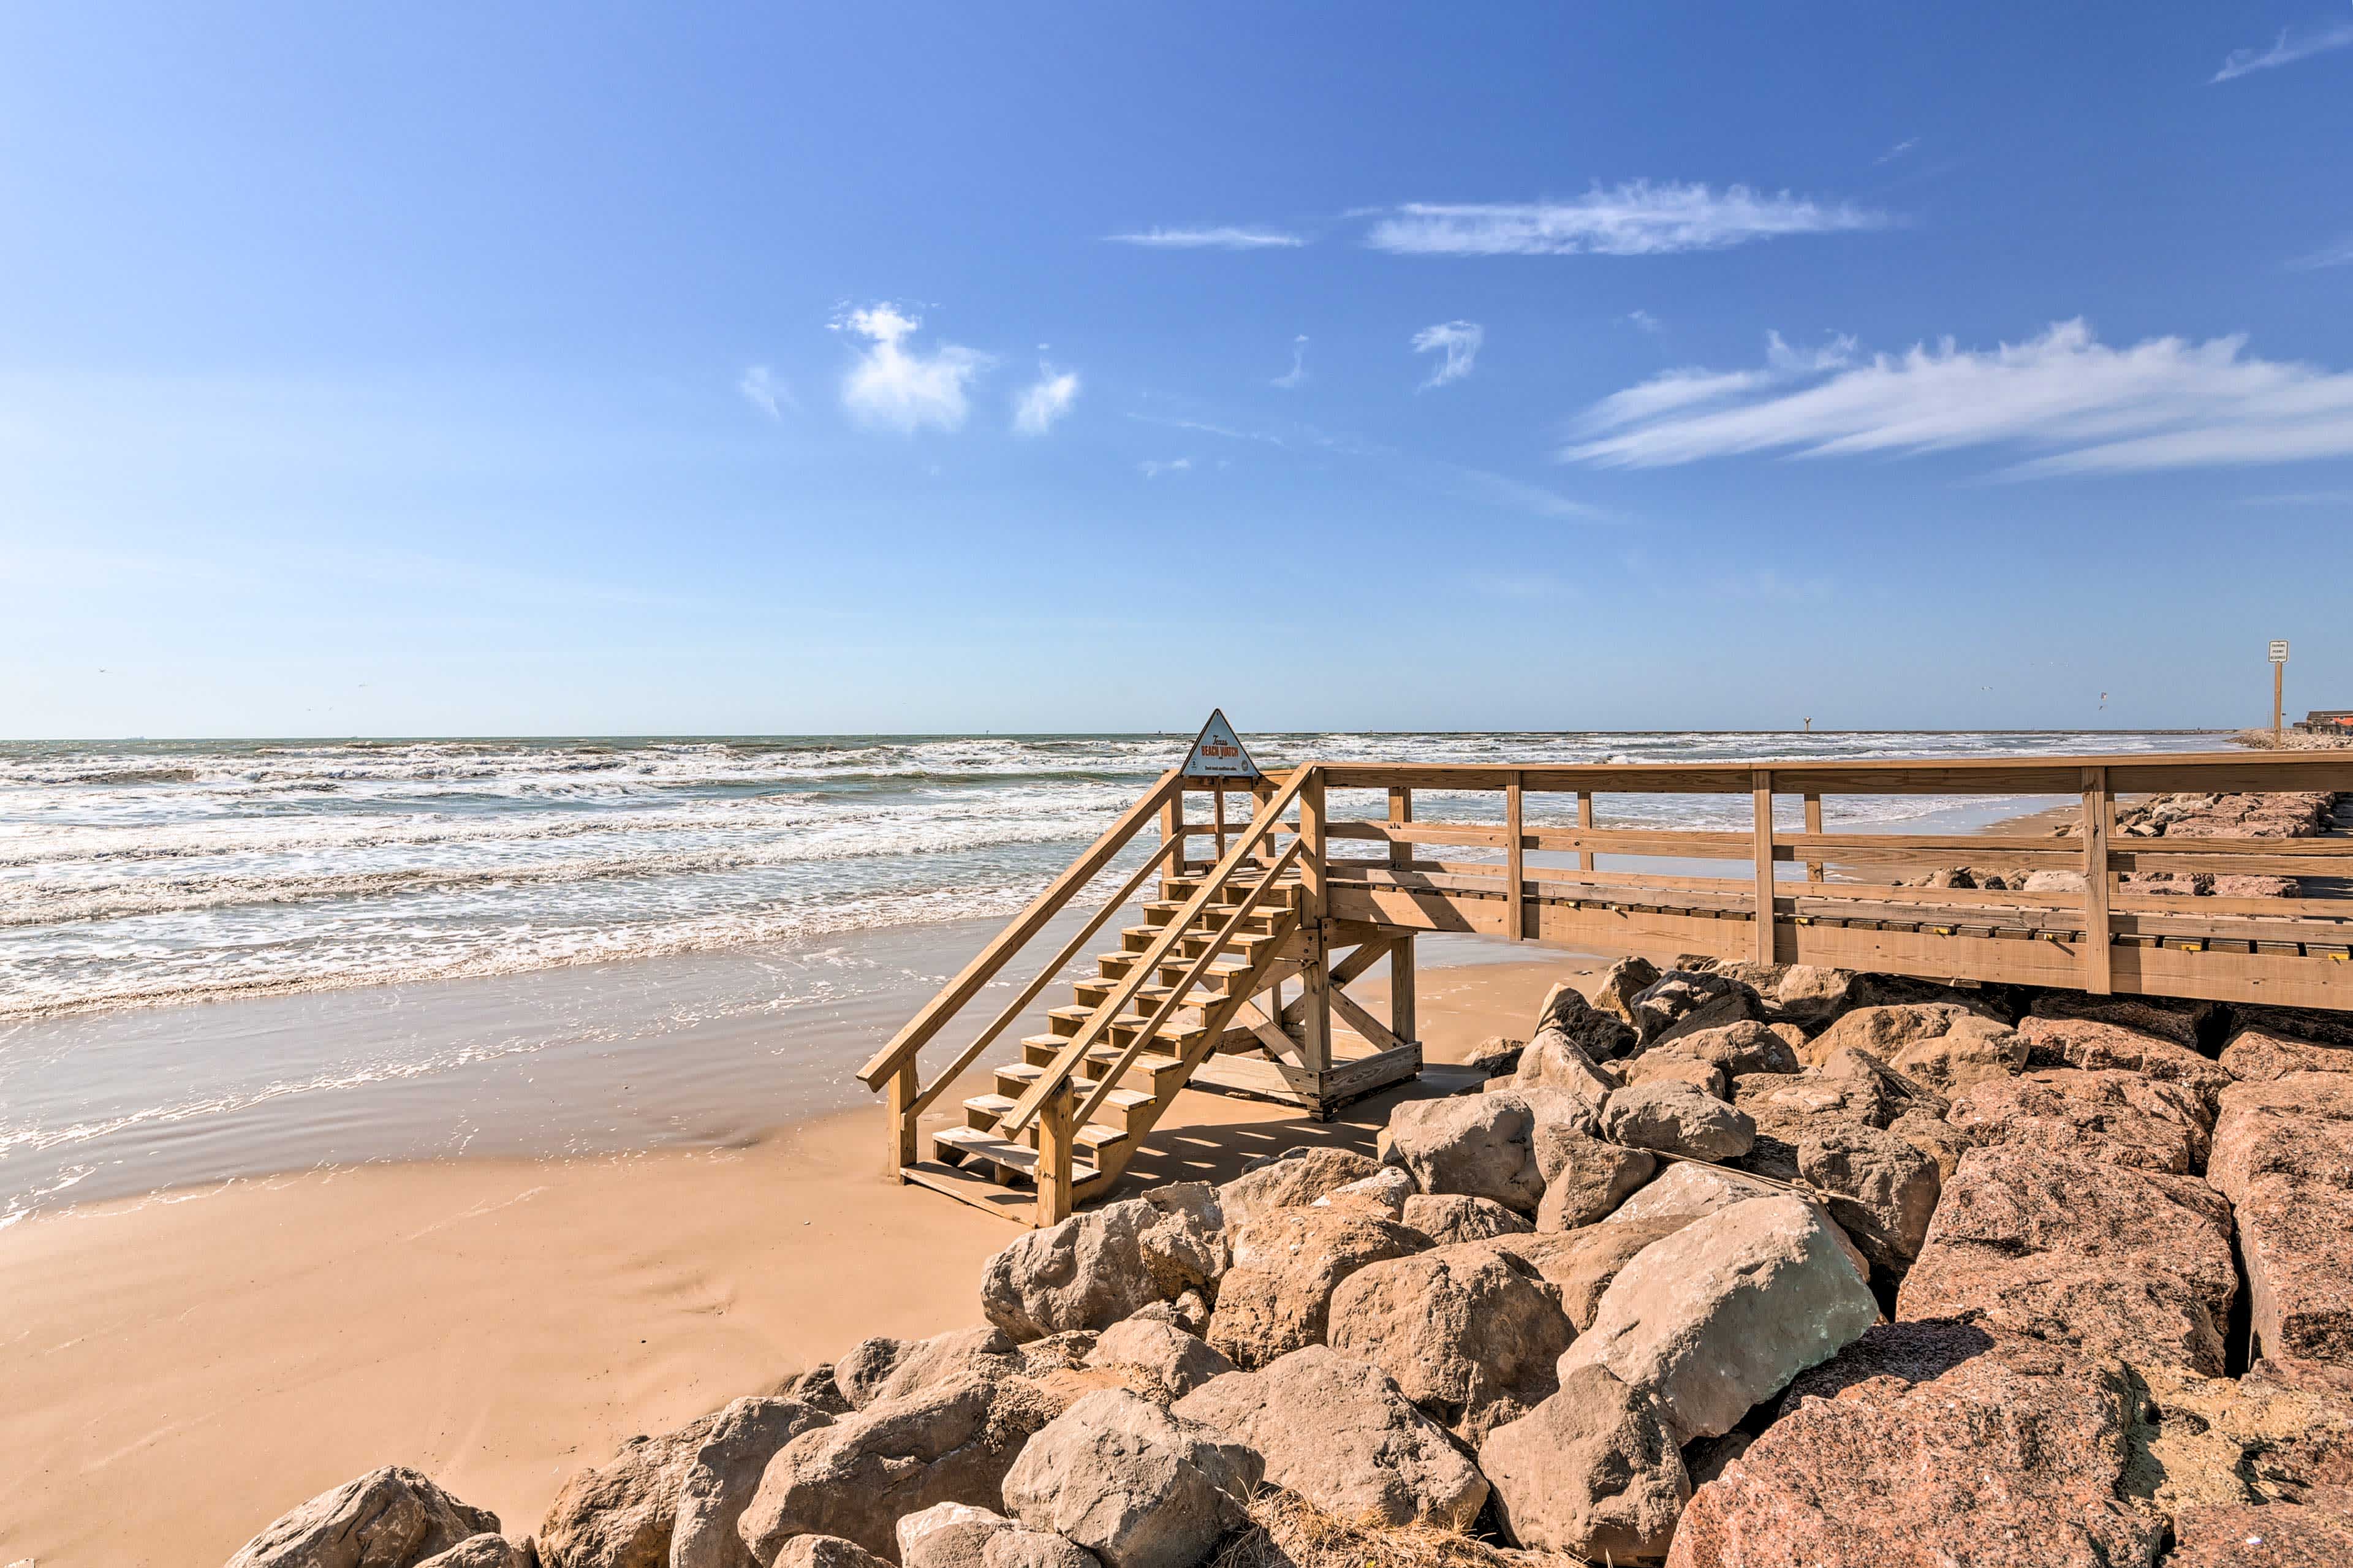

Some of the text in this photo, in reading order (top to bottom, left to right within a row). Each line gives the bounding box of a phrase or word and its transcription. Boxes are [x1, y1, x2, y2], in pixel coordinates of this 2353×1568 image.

[1213, 735, 1227, 746] Texas
[1201, 745, 1238, 757] BEACH WATCH
